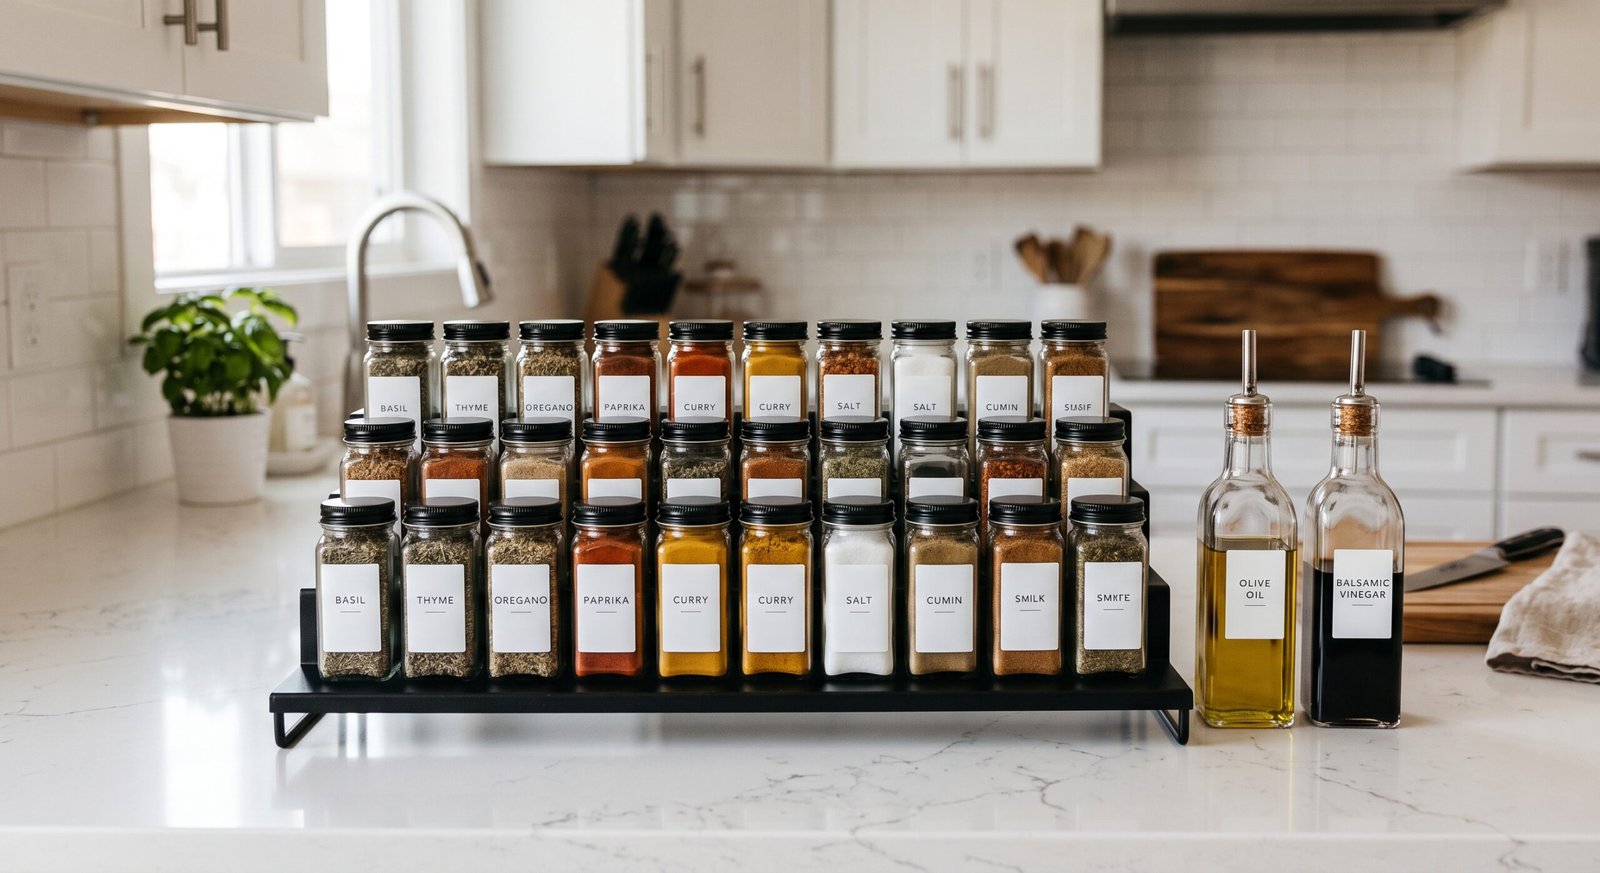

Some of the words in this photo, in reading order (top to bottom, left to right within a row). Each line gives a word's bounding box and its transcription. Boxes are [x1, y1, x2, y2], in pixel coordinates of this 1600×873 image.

[380, 404, 408, 413] BASIL
[455, 404, 489, 412] THYME
[525, 404, 574, 412] OREGANO
[604, 403, 646, 412] PAPRIKA
[683, 403, 716, 412] CURRY
[758, 403, 791, 411] CURRY
[837, 402, 862, 411] SALT
[913, 403, 937, 411] SALT
[985, 403, 1018, 411] CUMIN
[1239, 579, 1271, 588] OLIVE
[1336, 578, 1390, 588] BALSAMIC
[1015, 594, 1046, 603] SMILK
[1245, 591, 1265, 600] OIL
[1339, 590, 1386, 599] VINEGAR
[335, 595, 366, 605] BASIL
[416, 595, 454, 605] THYME
[494, 595, 548, 605] OREGANO
[583, 595, 630, 605] PAPRIKA
[672, 595, 709, 604] CURRY
[758, 595, 794, 605] CURRY
[846, 595, 872, 605] SALT
[926, 595, 963, 605] CUMIN
